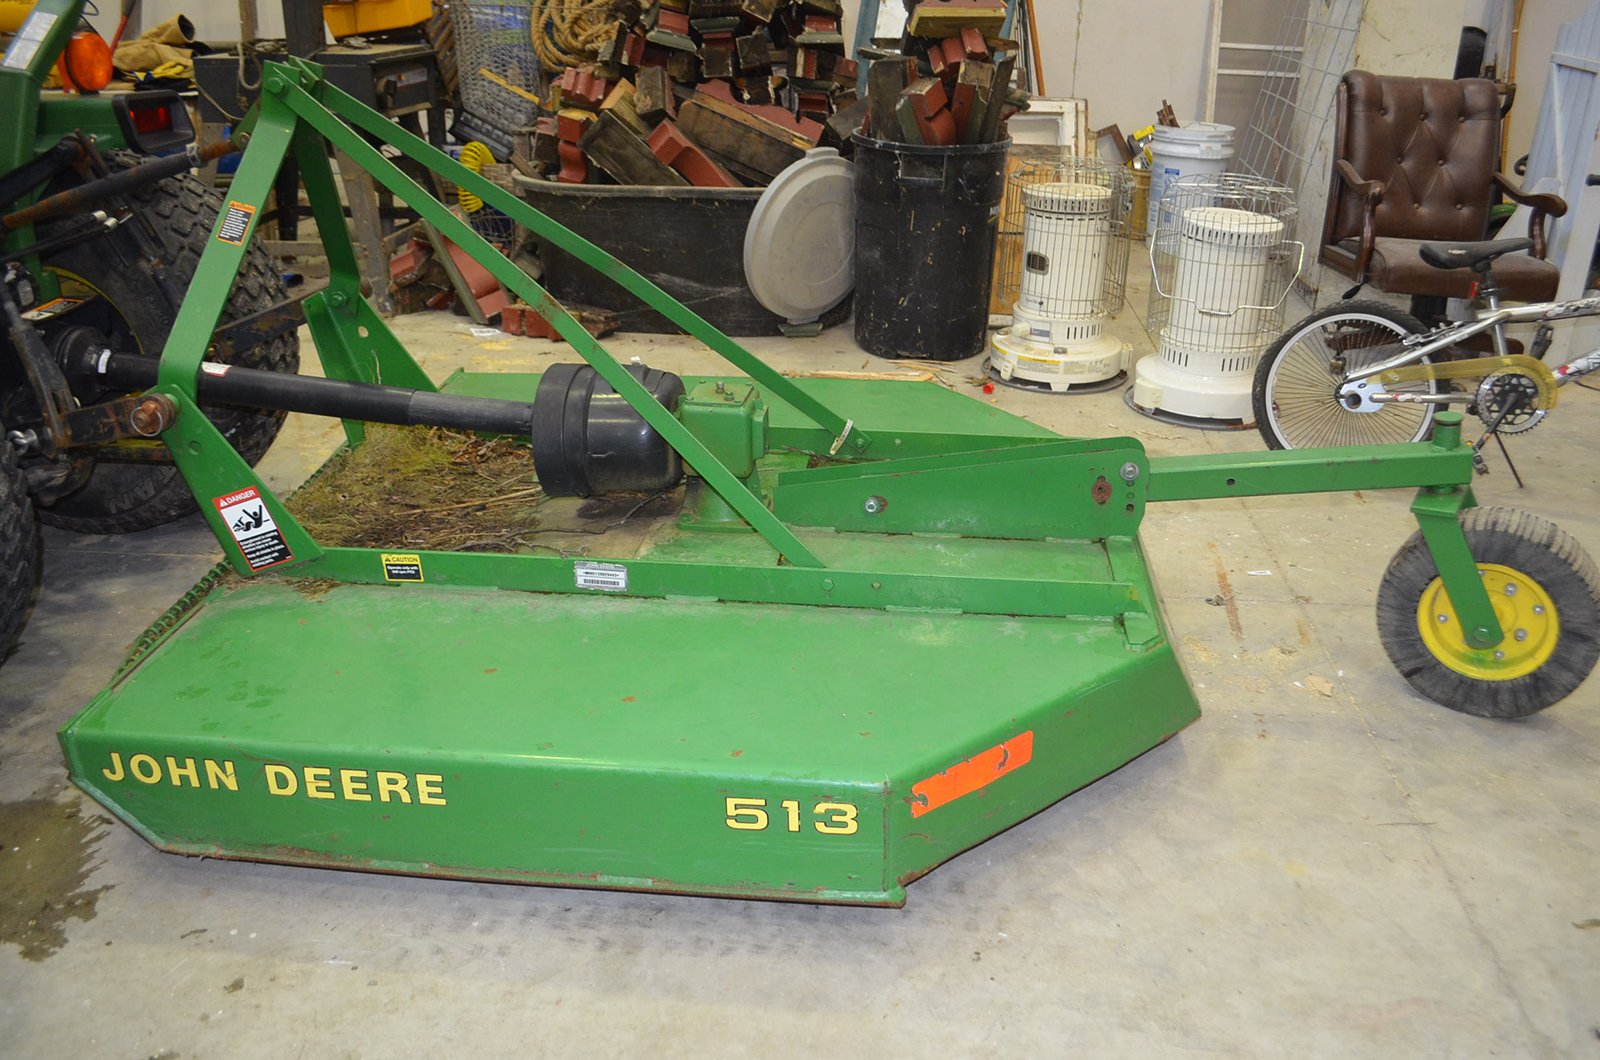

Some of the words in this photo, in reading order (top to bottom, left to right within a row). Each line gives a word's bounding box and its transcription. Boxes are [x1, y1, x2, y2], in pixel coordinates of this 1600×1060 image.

[226, 490, 256, 504] DANGER
[101, 751, 240, 792] JOHN
[263, 763, 448, 806] DEERE
[725, 796, 859, 836] 513
